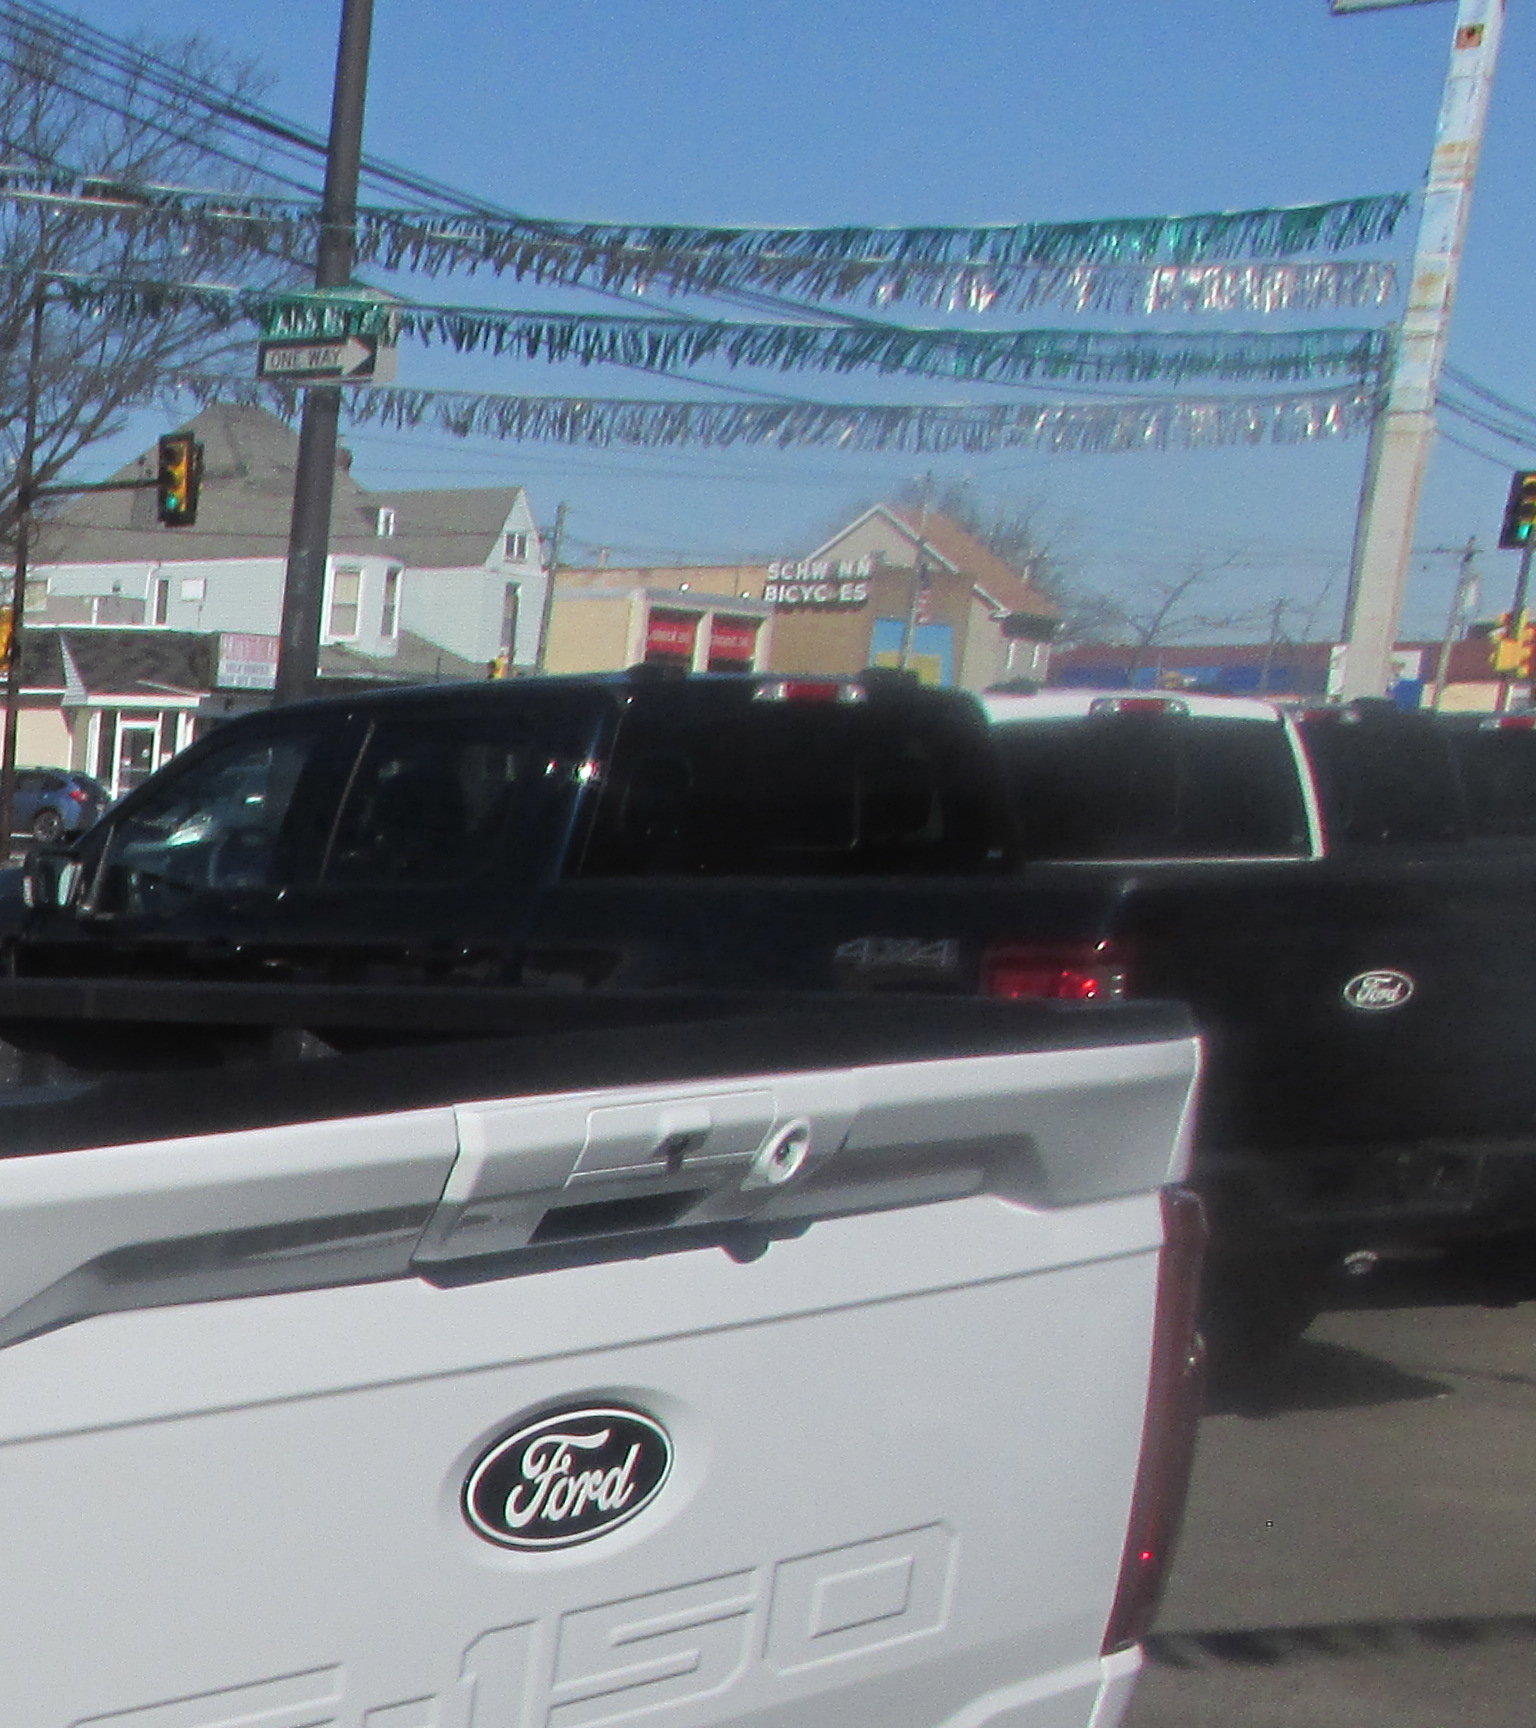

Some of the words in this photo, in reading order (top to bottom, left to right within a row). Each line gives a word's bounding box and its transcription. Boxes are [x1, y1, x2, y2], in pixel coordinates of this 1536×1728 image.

[308, 347, 341, 367] WAY
[766, 554, 872, 580] SCHWNN
[763, 583, 868, 602] BICYCES
[504, 1428, 641, 1528] Ford
